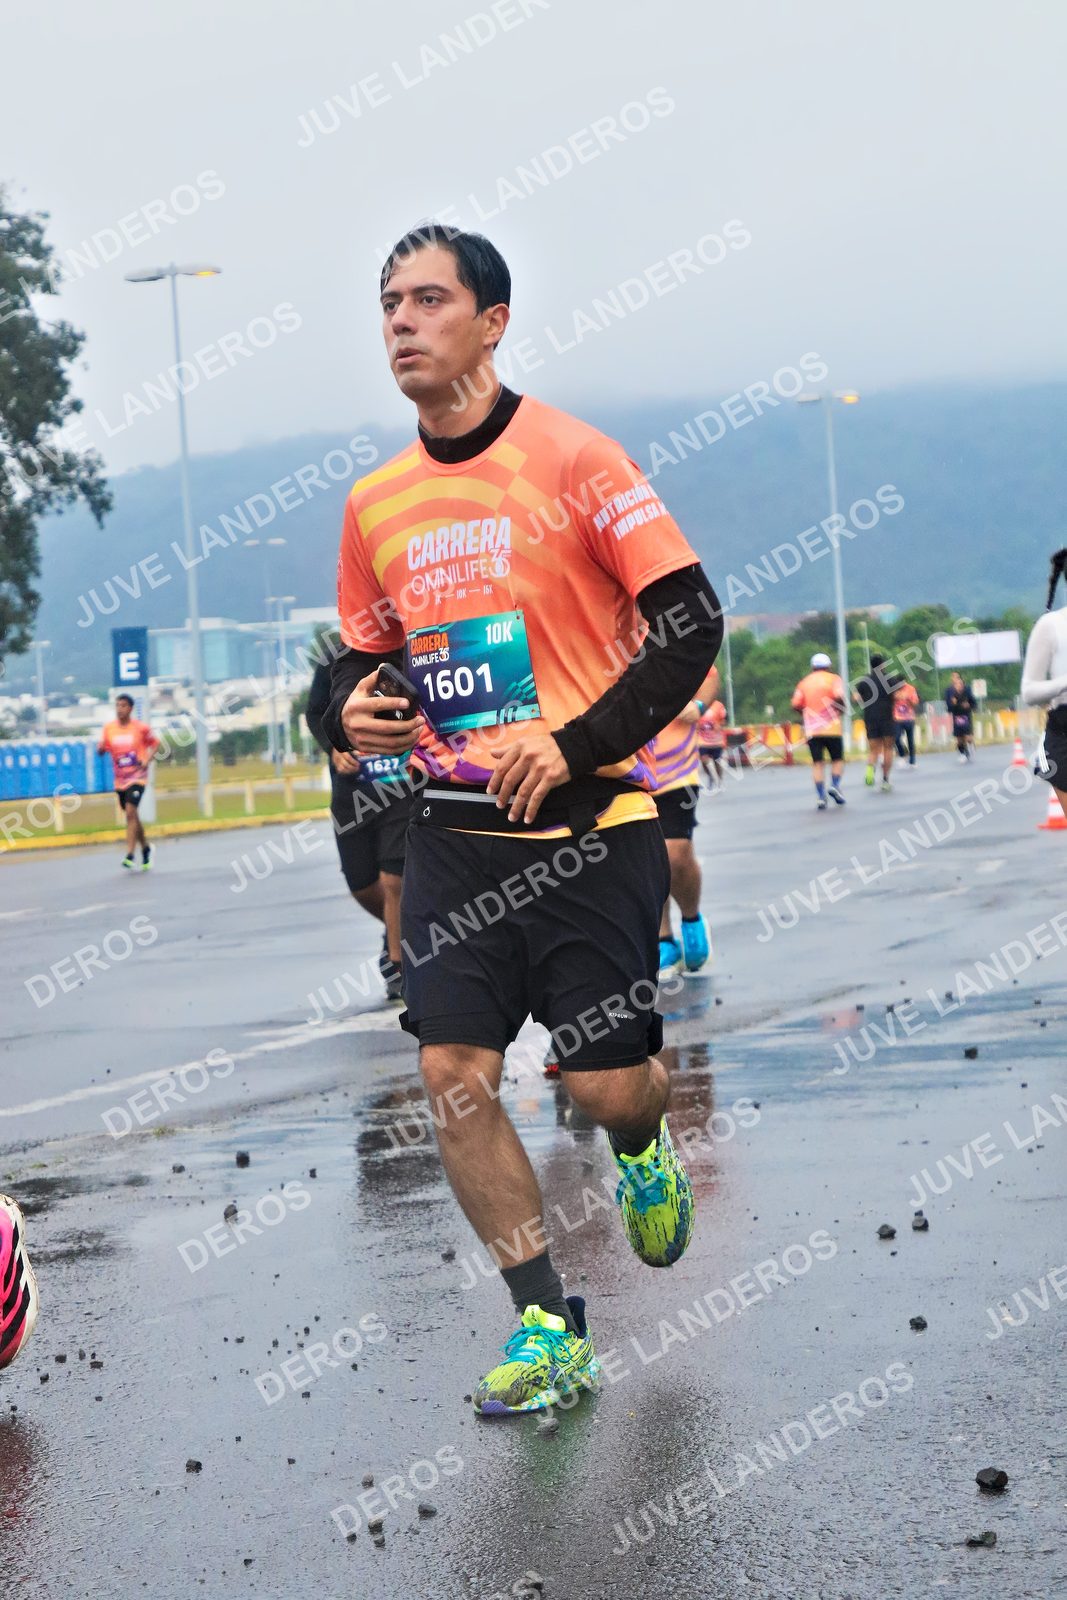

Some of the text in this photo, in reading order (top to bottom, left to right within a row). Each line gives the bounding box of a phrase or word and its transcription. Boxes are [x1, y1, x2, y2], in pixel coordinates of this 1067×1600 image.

[407, 516, 511, 571] CARRERA
[410, 632, 449, 656] CARRERA
[485, 621, 513, 645] 10K
[119, 652, 140, 680] E
[423, 663, 494, 702] 1601
[366, 758, 399, 774] 1627
